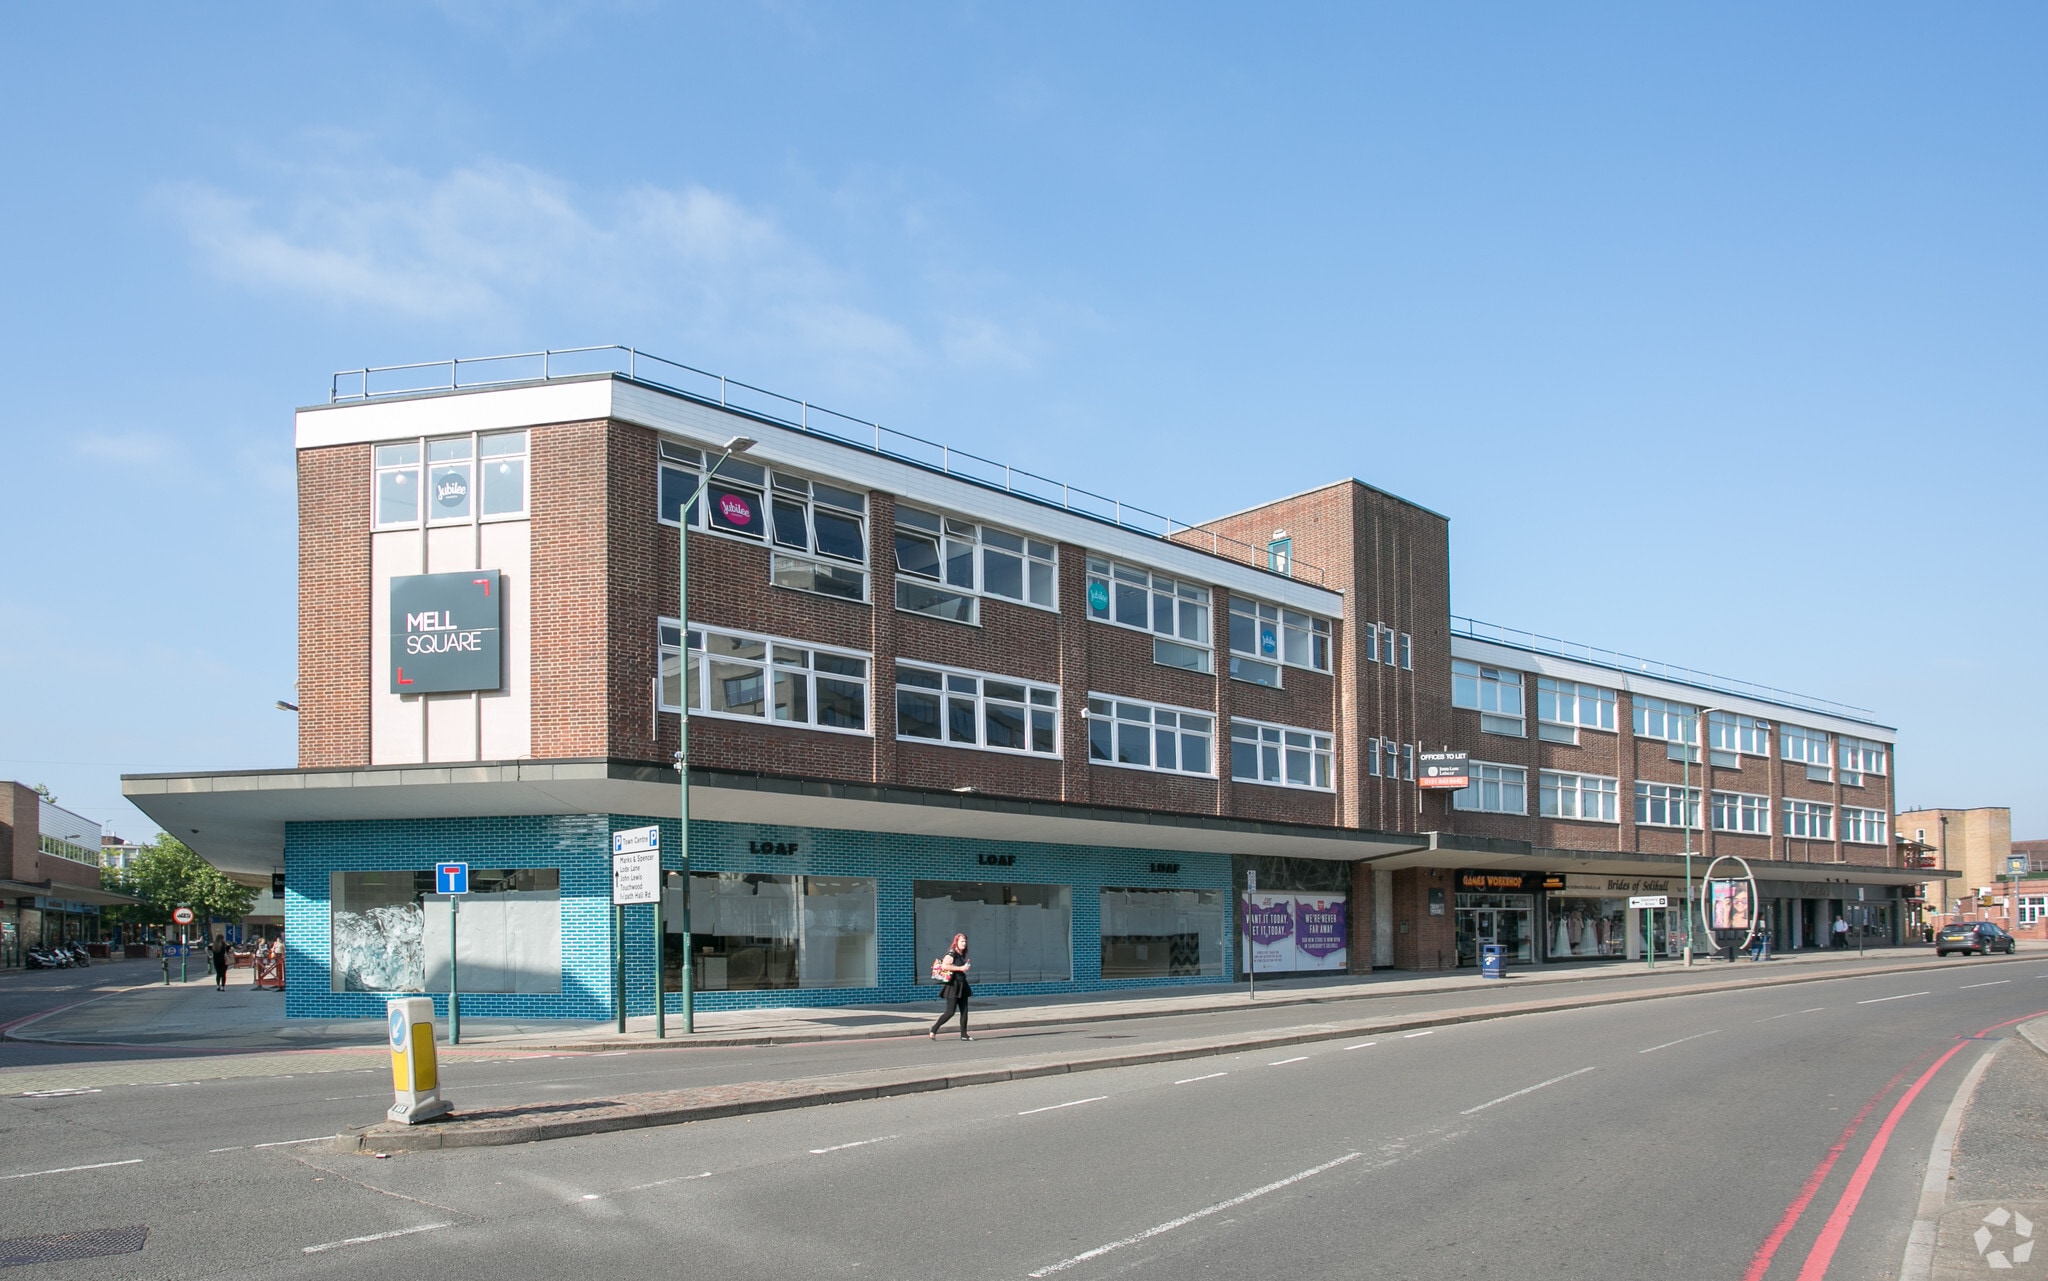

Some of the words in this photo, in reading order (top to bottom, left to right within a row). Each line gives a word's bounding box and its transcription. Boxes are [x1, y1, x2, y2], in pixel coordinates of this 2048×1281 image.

[406, 610, 458, 632] MELL
[406, 631, 482, 655] SQUARE
[1420, 753, 1445, 761] OFFICES
[1455, 752, 1467, 760] LET
[623, 838, 633, 846] Town
[635, 836, 649, 844] Centre
[749, 841, 799, 856] LOAF
[620, 856, 632, 864] Marks
[637, 854, 655, 862] Spencer
[978, 854, 1017, 866] LOAF
[1150, 862, 1181, 874] LOAF
[620, 883, 643, 891] Touchwood
[1462, 875, 1486, 887] GAMES
[1486, 876, 1523, 888] WORKSHOP
[1607, 879, 1630, 891] Brides
[1631, 880, 1641, 895] of
[1642, 880, 1670, 891] Solihull
[645, 890, 651, 898] Rd
[1263, 913, 1269, 924] IT
[1305, 913, 1320, 923] WE'RE
[1321, 913, 1337, 923] NEVER
[1309, 924, 1319, 934] FAR
[1319, 924, 1333, 934] AWAY
